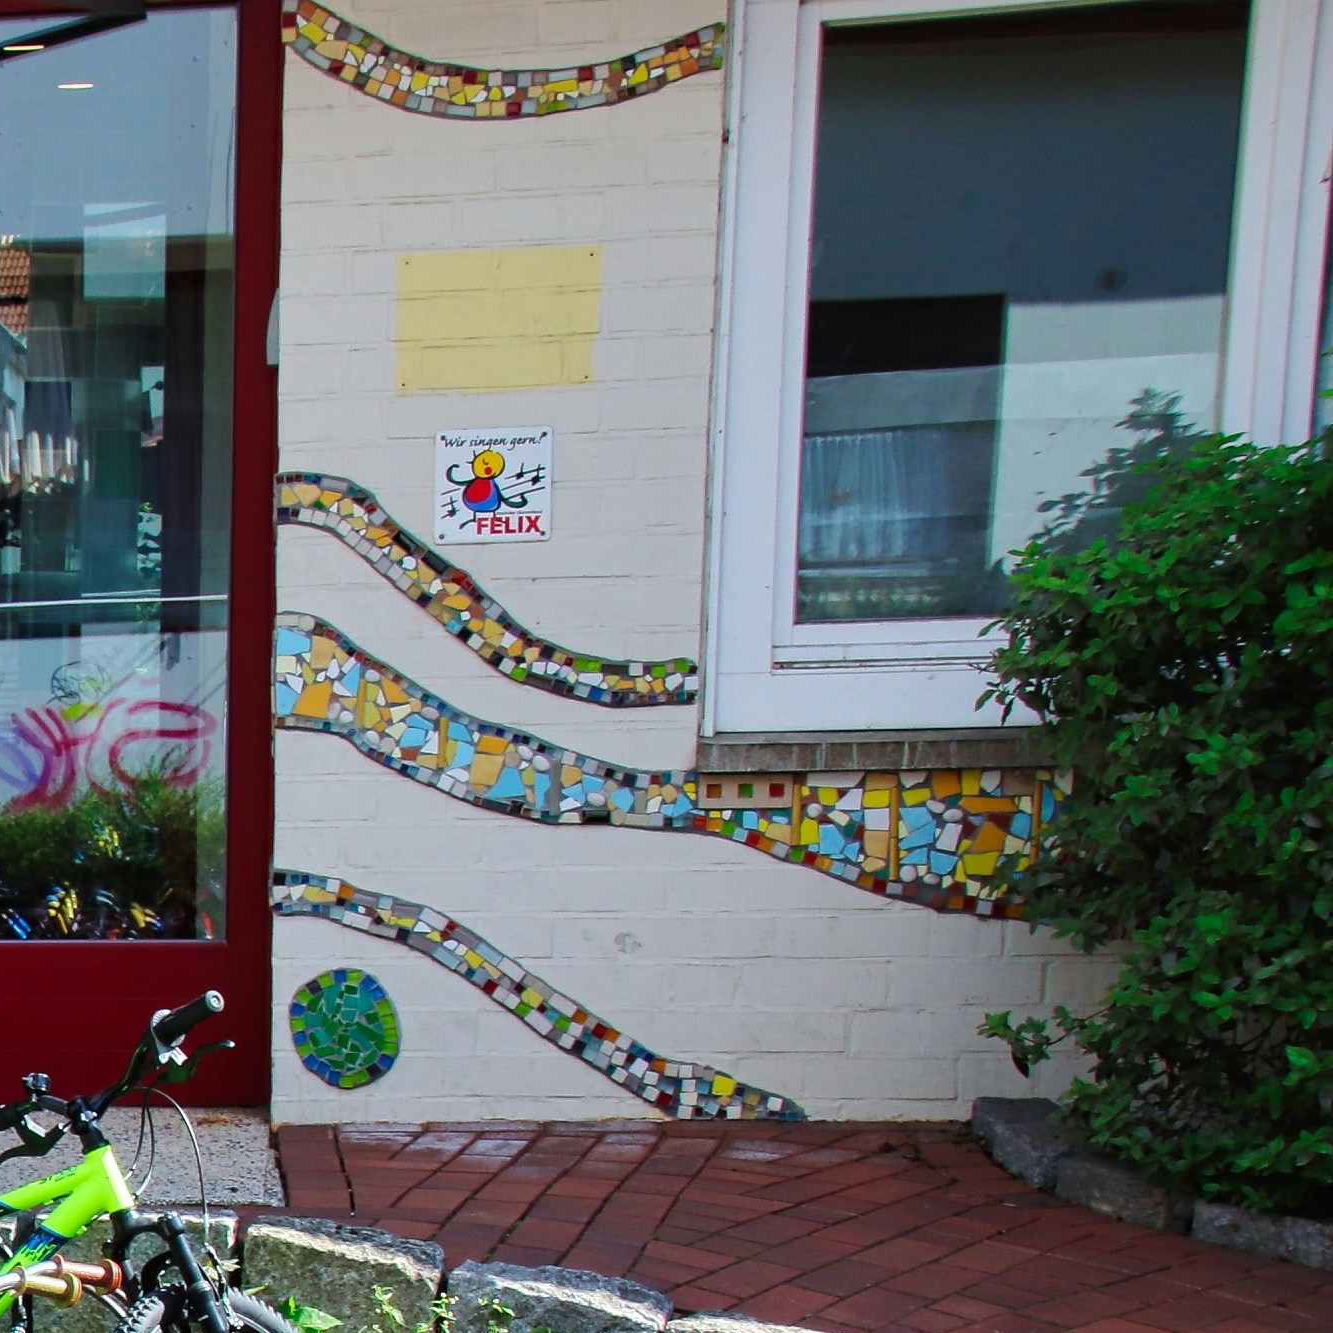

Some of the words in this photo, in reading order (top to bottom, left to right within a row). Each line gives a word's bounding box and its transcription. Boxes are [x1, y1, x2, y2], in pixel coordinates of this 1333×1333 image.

[443, 436, 466, 448] Wir
[469, 436, 507, 451] singen
[507, 434, 544, 452] gern!
[476, 515, 542, 535] FELIX
